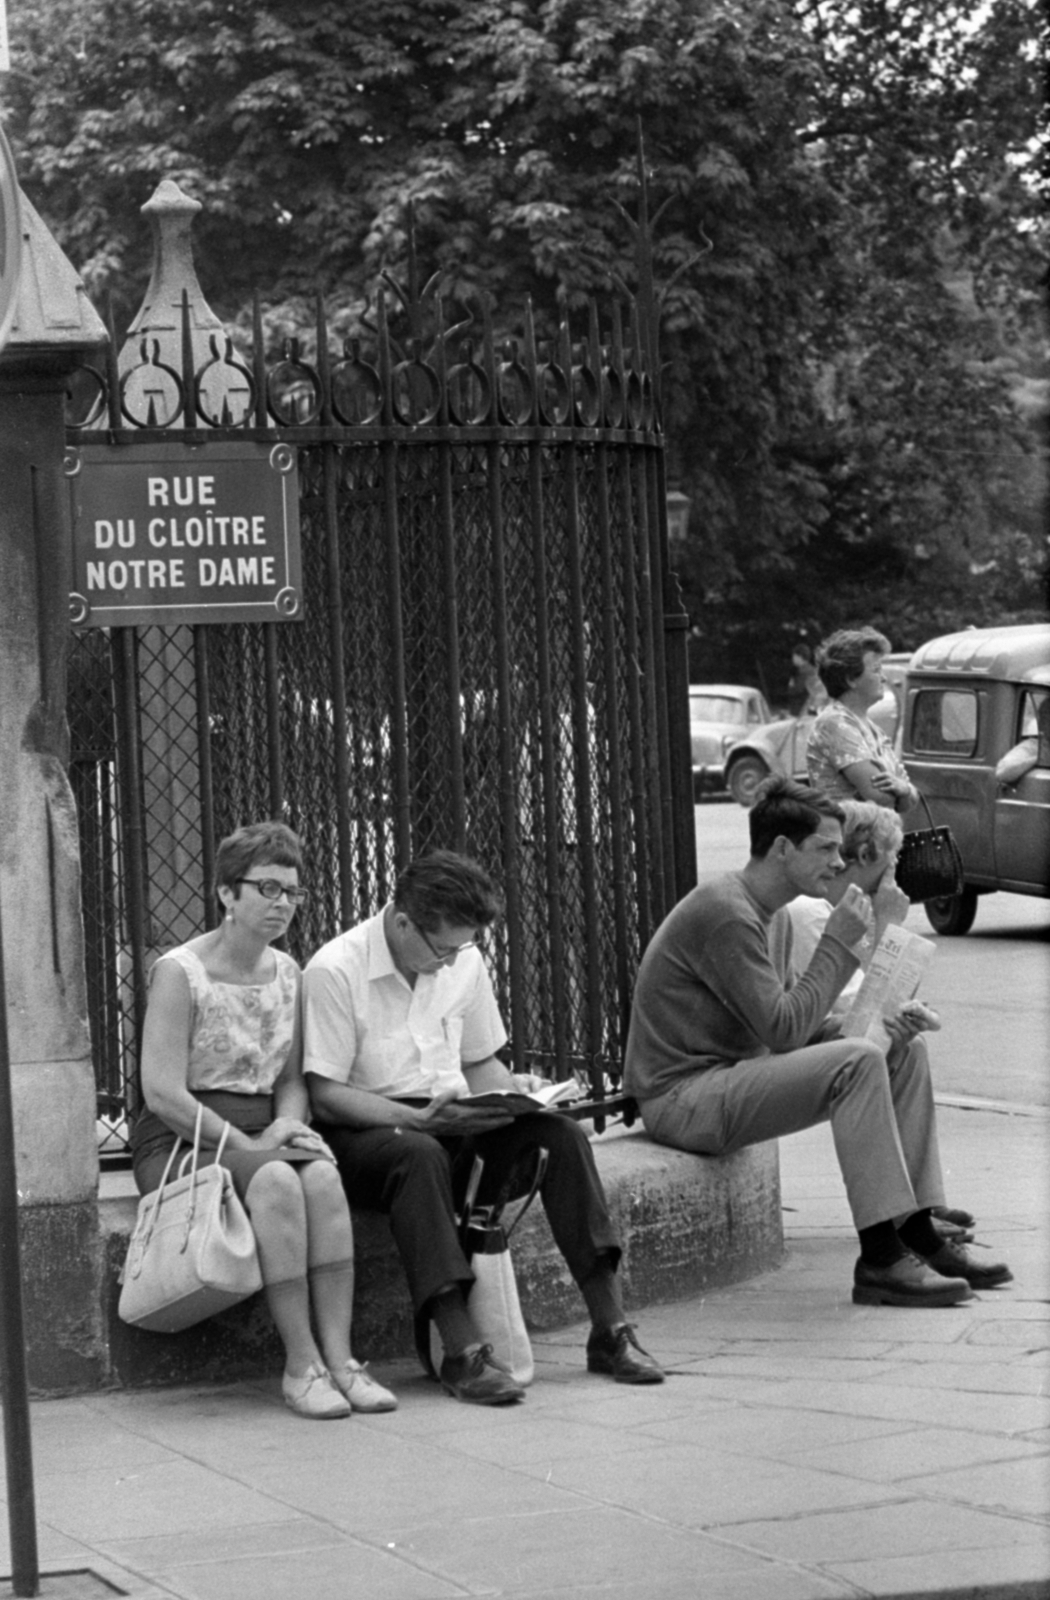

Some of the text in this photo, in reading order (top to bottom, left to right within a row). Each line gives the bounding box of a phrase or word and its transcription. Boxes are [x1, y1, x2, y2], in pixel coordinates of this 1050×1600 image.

[148, 476, 216, 506] RUE
[95, 510, 266, 549] DU CLOÎTRE
[86, 556, 276, 590] NOTRE DAME
